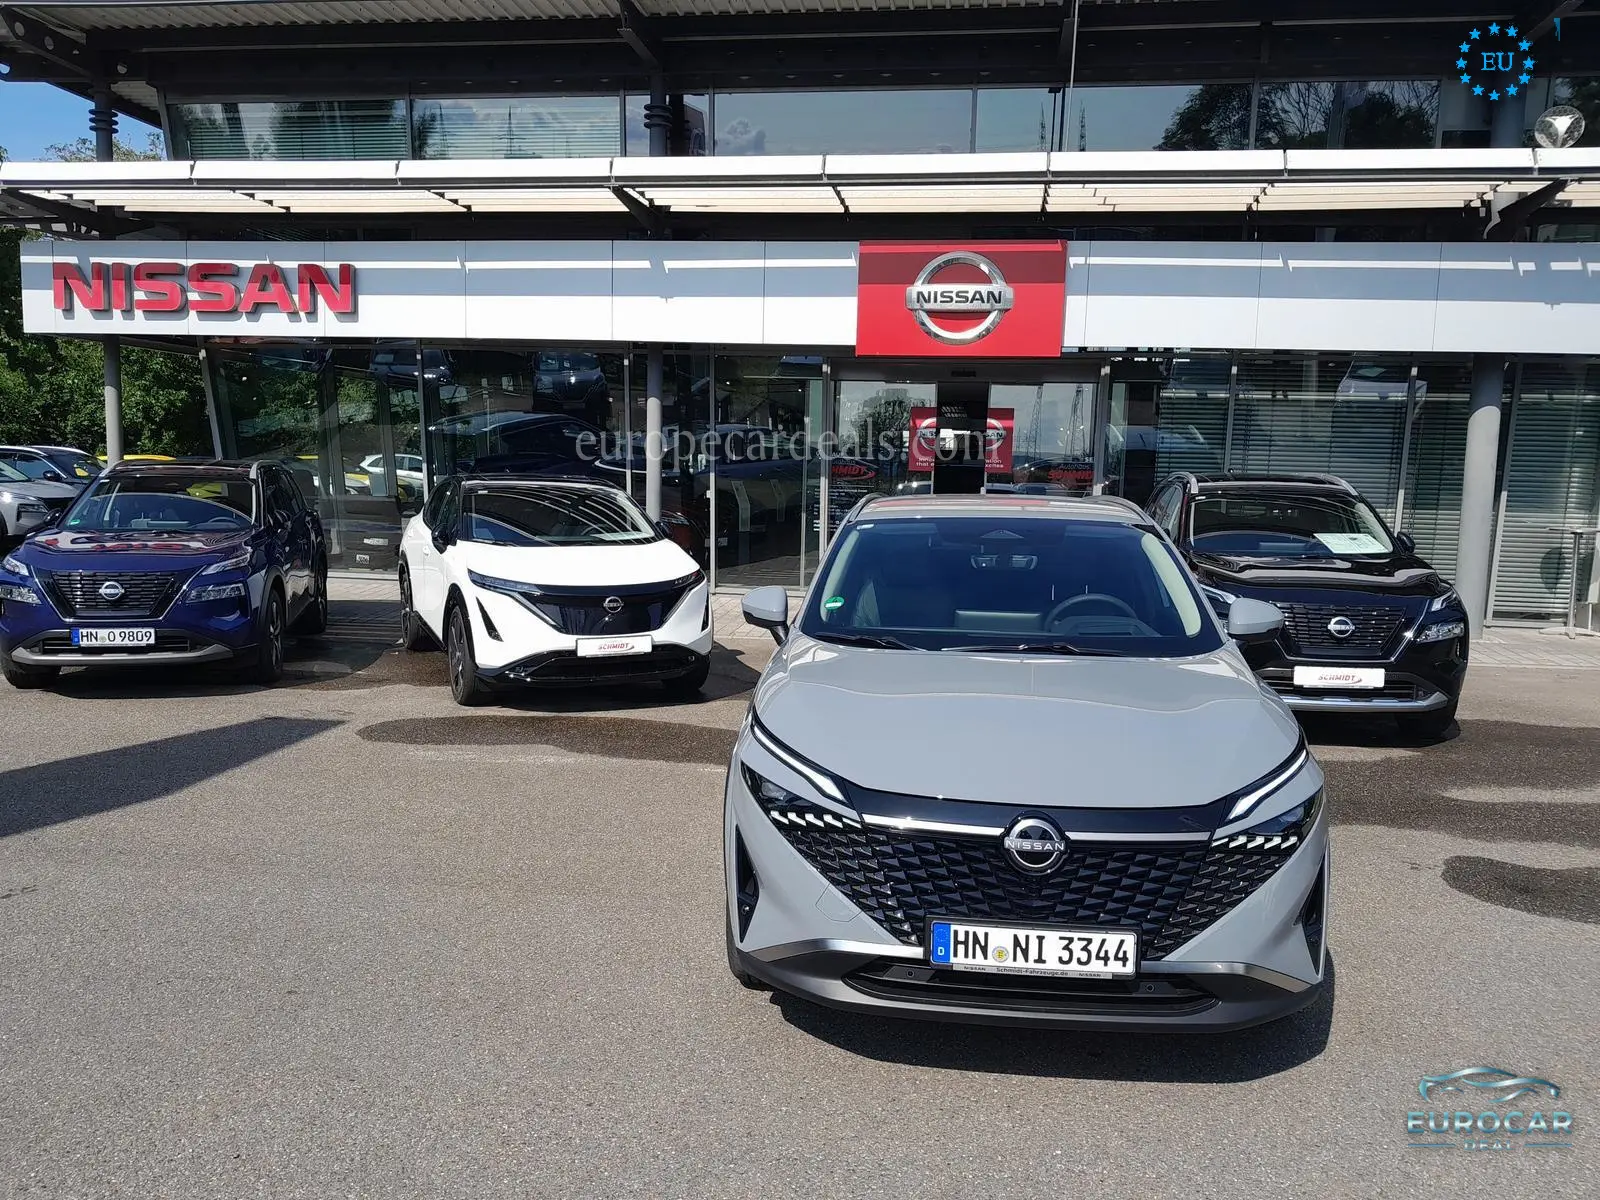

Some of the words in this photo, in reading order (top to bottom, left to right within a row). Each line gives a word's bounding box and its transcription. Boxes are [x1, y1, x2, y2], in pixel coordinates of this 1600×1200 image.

[53, 262, 356, 314] NISSAN
[916, 290, 1003, 305] NISSAN
[80, 630, 98, 643] HN
[118, 630, 152, 643] 9809
[599, 642, 629, 650] SCHMIDT
[1005, 839, 1064, 851] NISSAN
[937, 946, 945, 956] D
[952, 929, 989, 961] HN
[1012, 933, 1047, 964] NI
[1058, 936, 1129, 968] 3344
[996, 966, 1069, 977] Schmidt-Fahrzeuge.de
